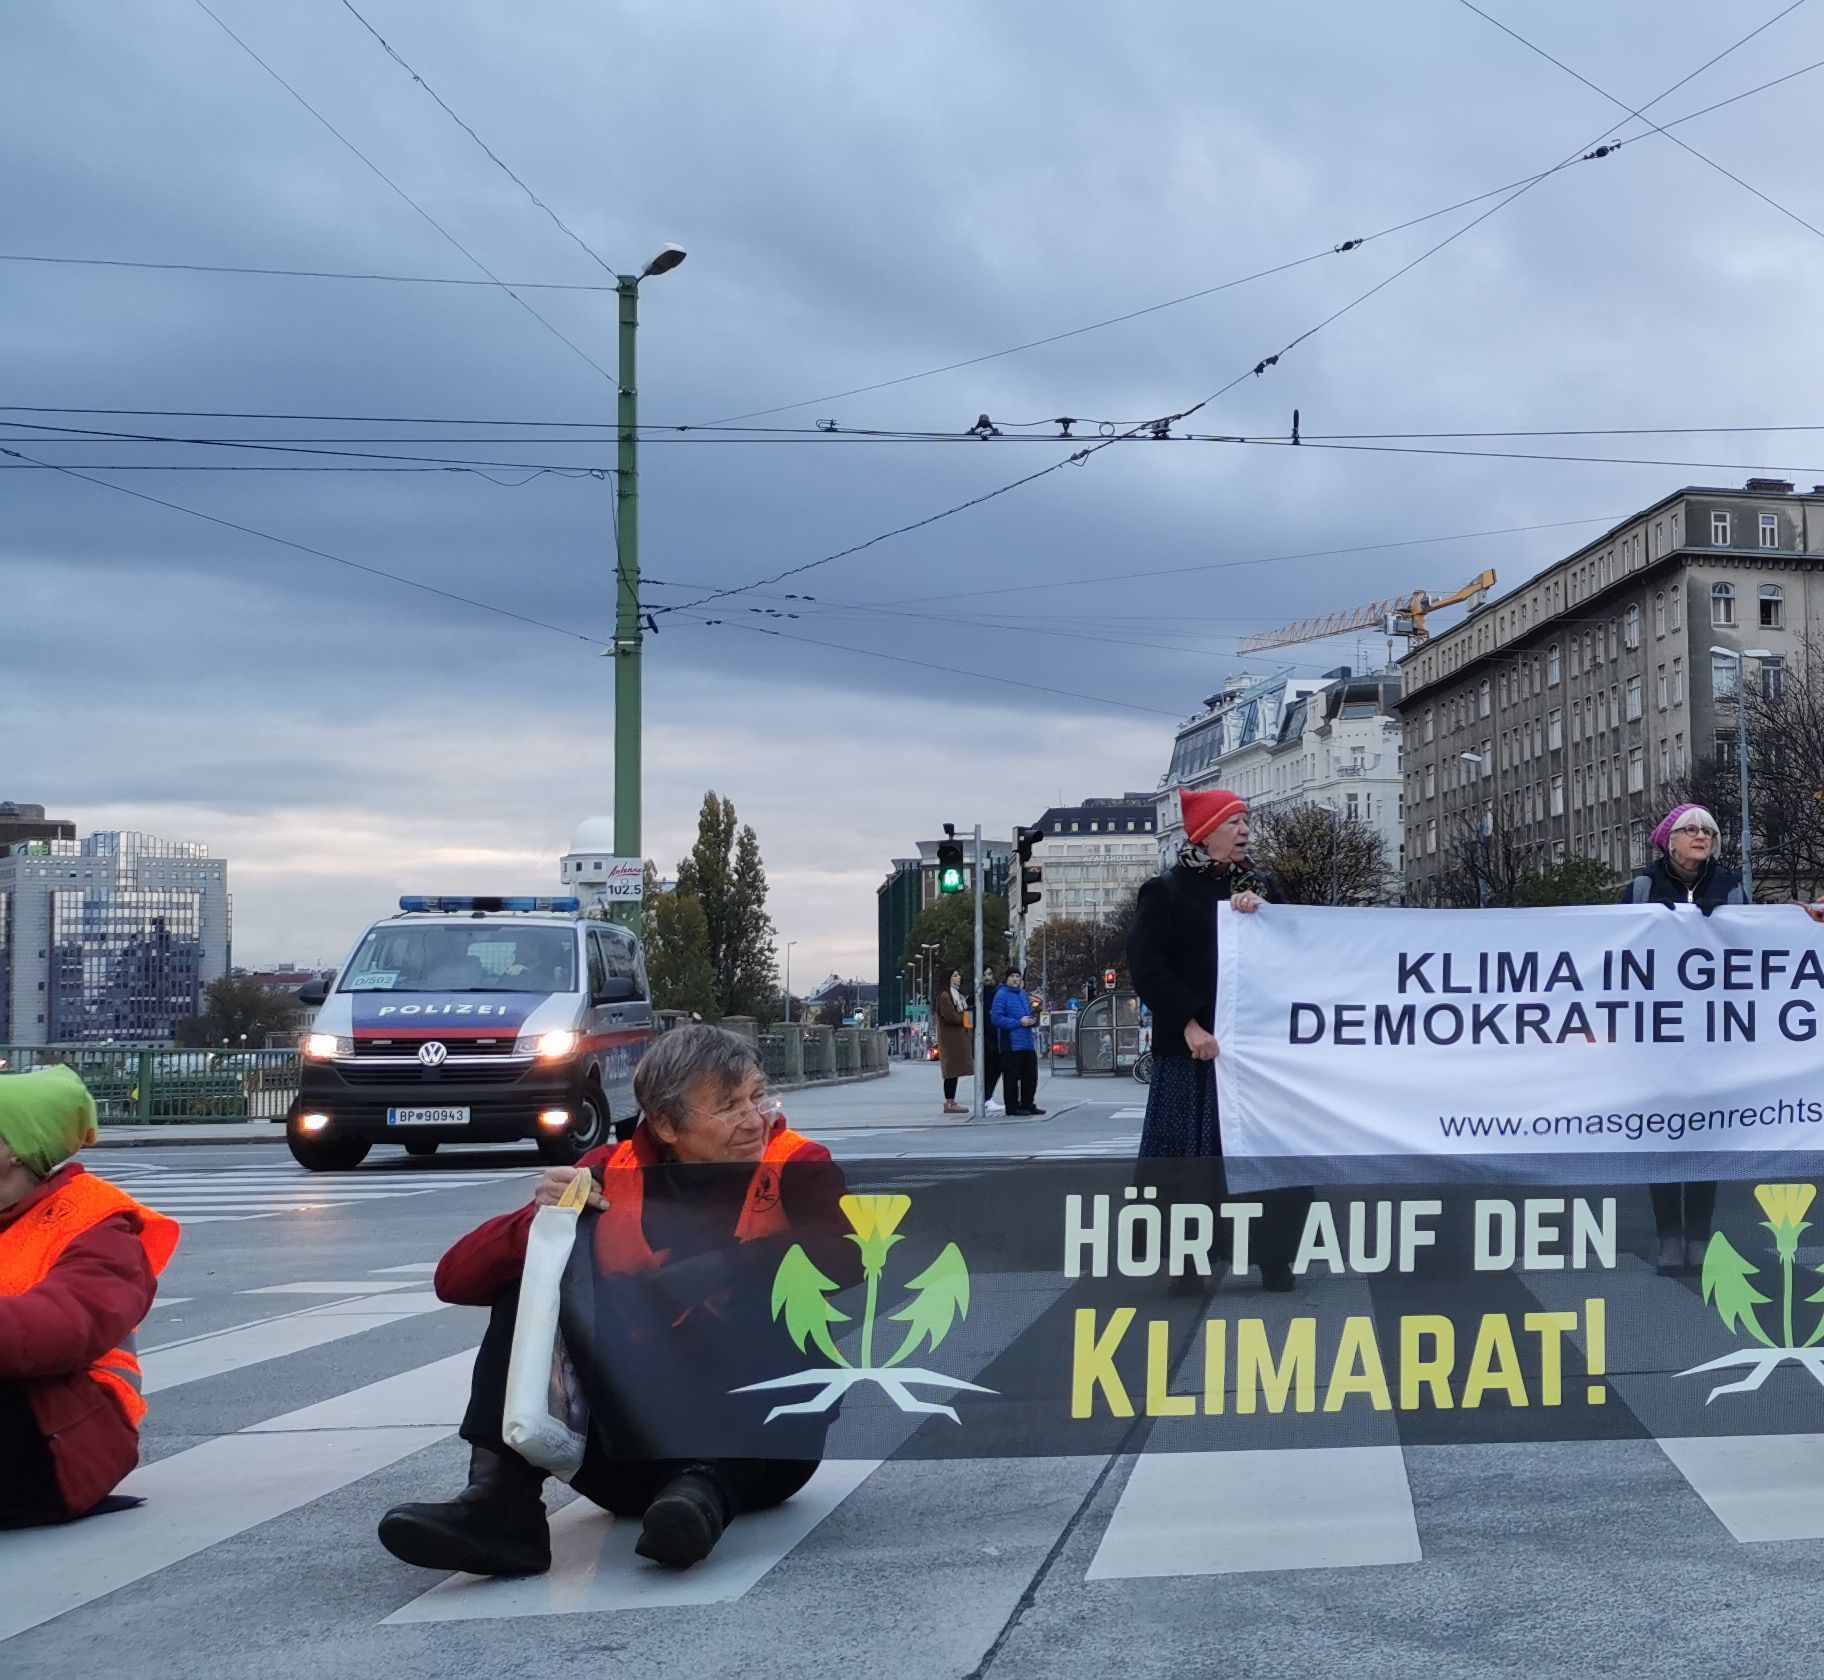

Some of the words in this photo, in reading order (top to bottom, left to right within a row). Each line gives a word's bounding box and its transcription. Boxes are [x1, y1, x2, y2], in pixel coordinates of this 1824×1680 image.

[608, 884, 642, 895] 102.5
[1398, 951, 1584, 993] KLIMA
[1603, 949, 1655, 991] IN
[378, 1004, 508, 1016] POLIZEI
[1289, 1000, 1684, 1045] DEMOKRATIE
[1706, 1000, 1755, 1042] IN
[400, 1110, 416, 1122] BP
[424, 1110, 464, 1122] 90943
[1064, 1187, 1263, 1278] HÖRT
[1293, 1200, 1442, 1274] AUF
[1474, 1197, 1617, 1271] DEN
[1071, 1298, 1606, 1418] KLIMARAT!
